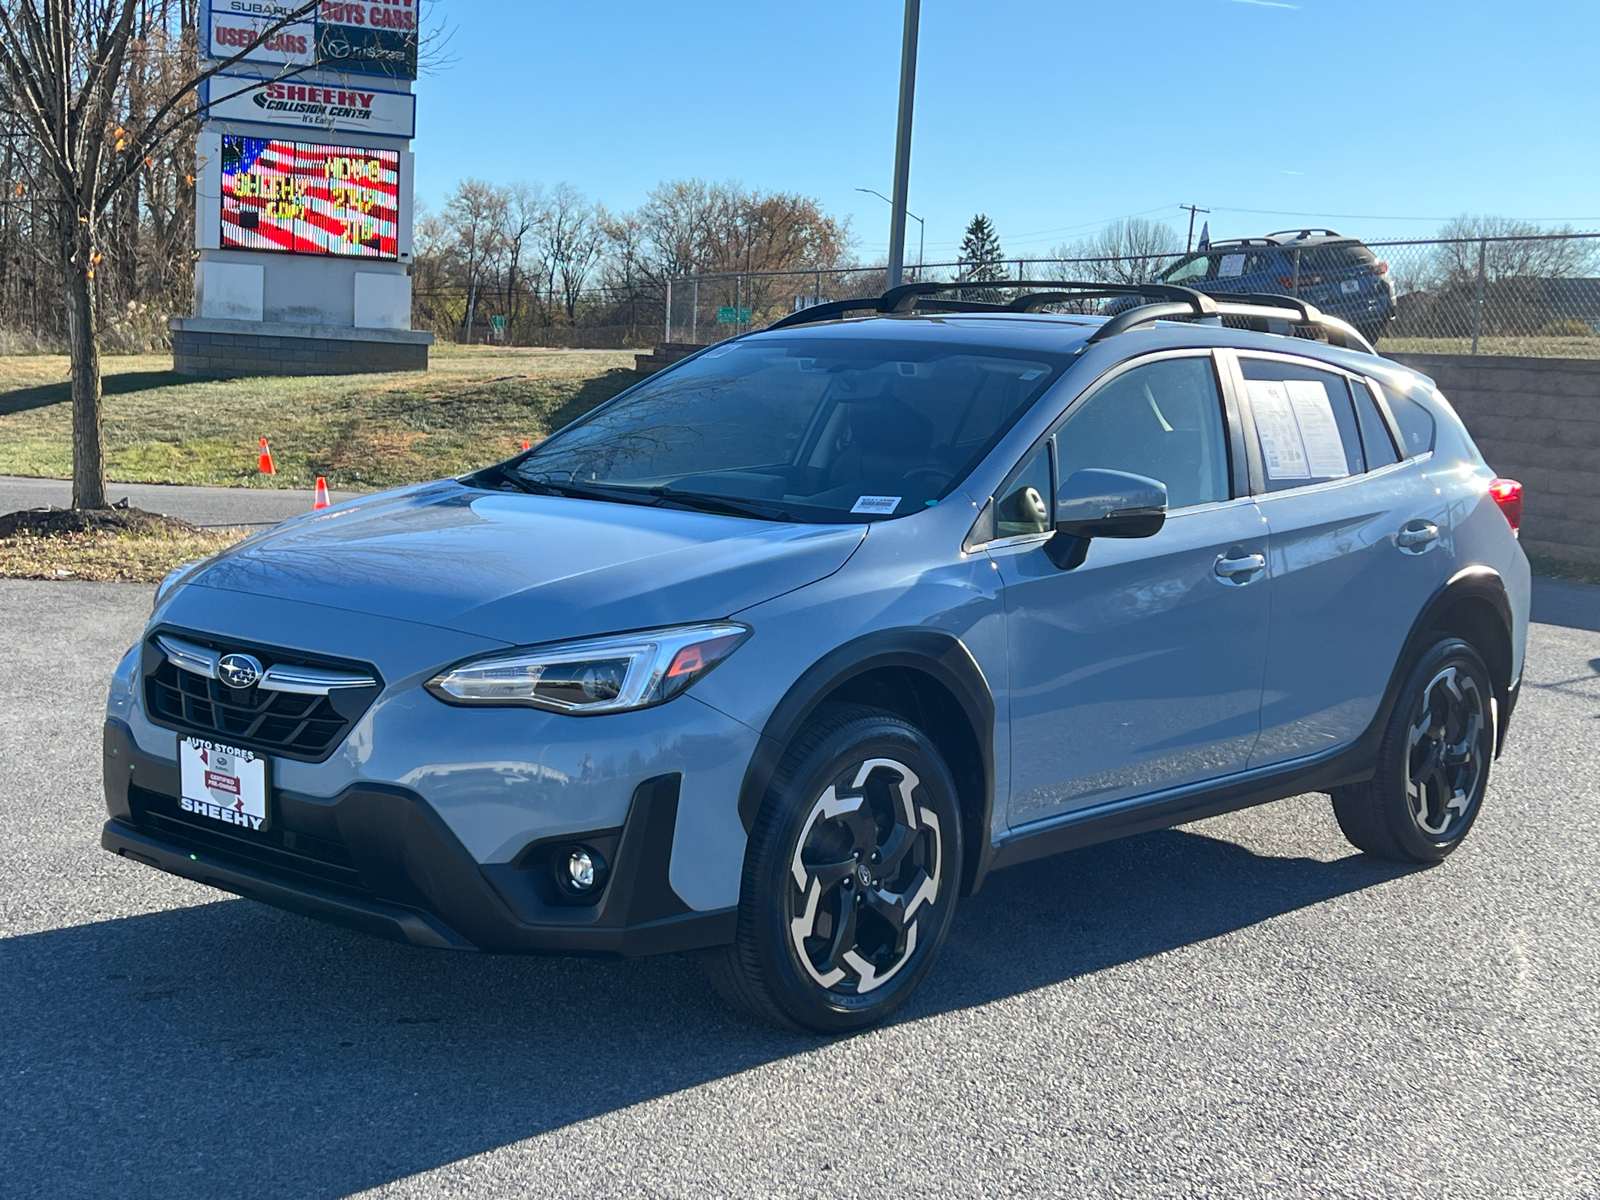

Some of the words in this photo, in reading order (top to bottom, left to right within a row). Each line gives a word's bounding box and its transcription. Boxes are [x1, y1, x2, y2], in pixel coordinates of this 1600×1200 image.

[321, 1, 365, 24] BUYS
[370, 6, 413, 30] CARS
[216, 26, 259, 48] USED
[263, 33, 307, 54] CARS
[266, 84, 375, 108] SHEEHY
[266, 100, 327, 114] COLLISION
[328, 107, 372, 120] CENTER
[301, 114, 313, 123] It's
[186, 736, 212, 750] AUTO
[214, 743, 254, 760] STORES
[181, 798, 263, 830] SHEEHY
